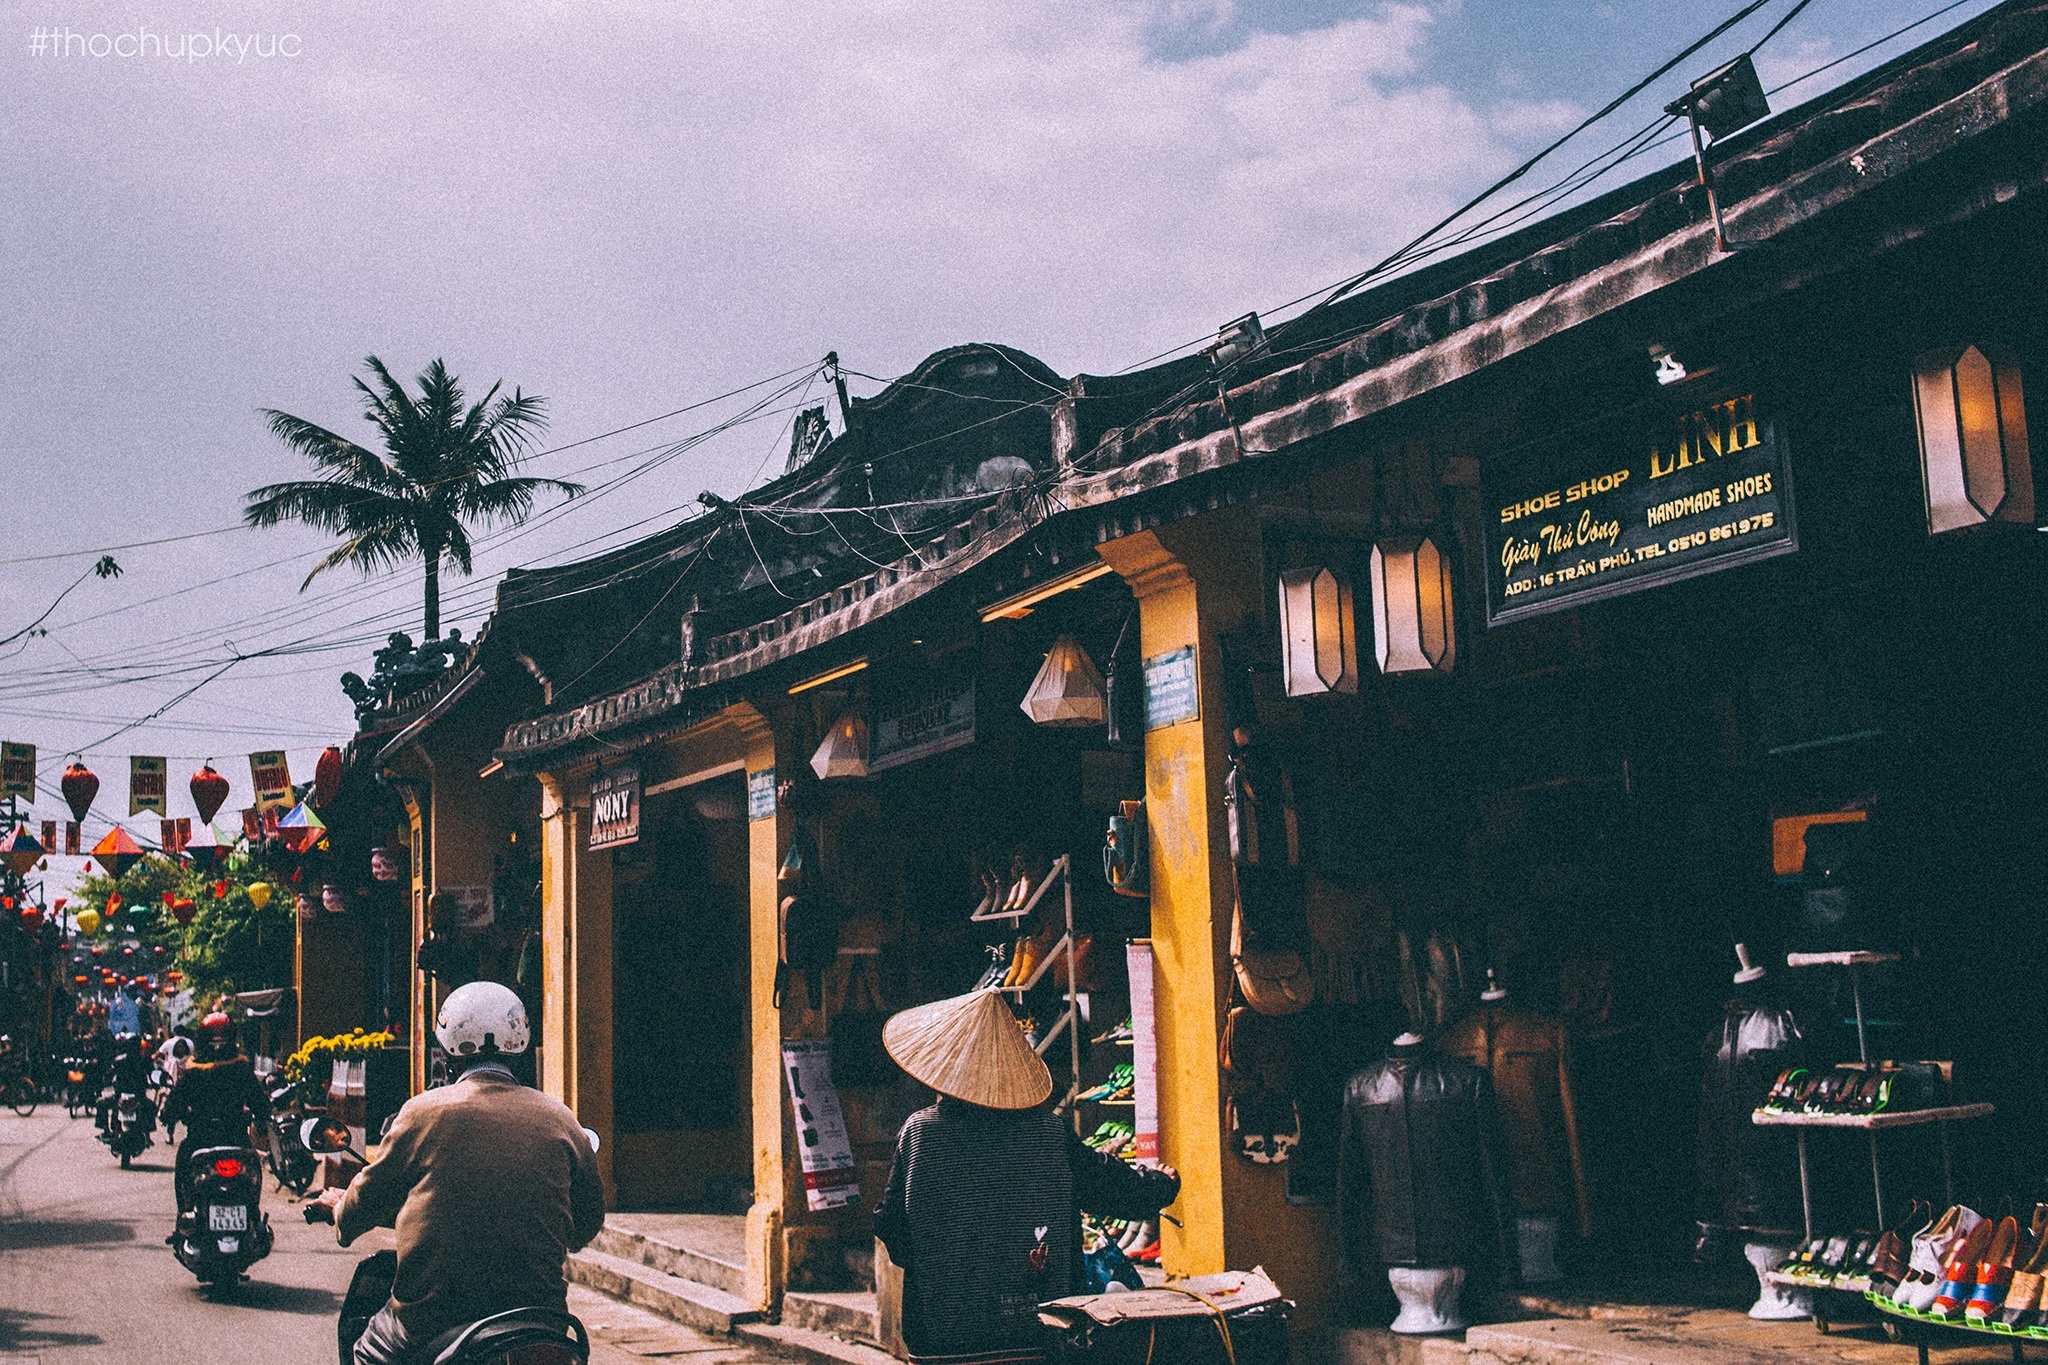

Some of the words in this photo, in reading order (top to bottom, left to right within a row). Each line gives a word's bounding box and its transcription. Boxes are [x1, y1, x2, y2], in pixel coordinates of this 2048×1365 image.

[1501, 490, 1560, 523] SHOE
[1566, 469, 1630, 503] SHOP
[1649, 394, 1761, 479] LINH
[1502, 536, 1541, 577] Giày
[1576, 508, 1620, 547] Công
[1647, 487, 1721, 528] HANDMADE
[1727, 472, 1773, 503] SHOES
[1540, 572, 1554, 587] 16
[1668, 531, 1707, 553] 0510
[1709, 511, 1774, 542] 861975
